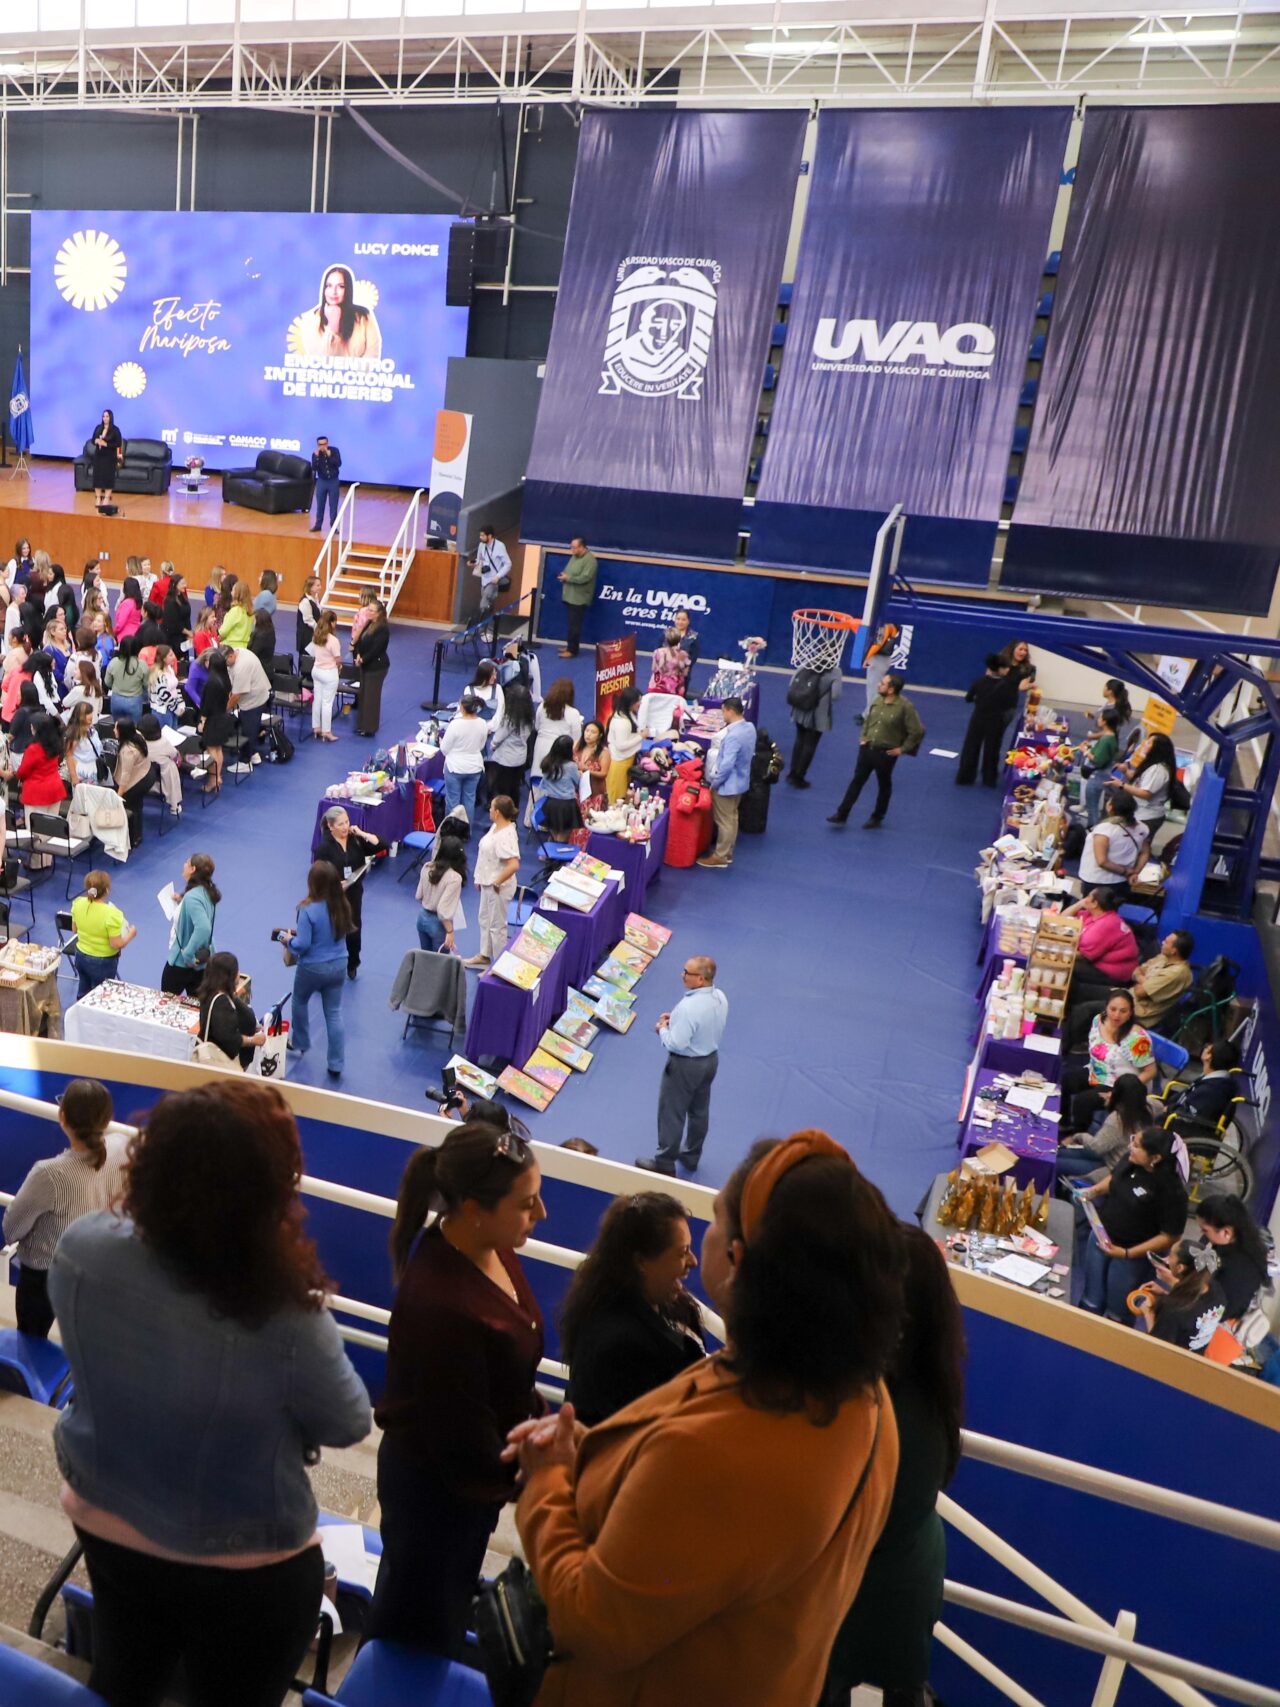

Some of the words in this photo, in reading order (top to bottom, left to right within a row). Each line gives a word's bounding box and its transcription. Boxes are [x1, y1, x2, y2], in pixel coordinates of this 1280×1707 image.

[354, 243, 389, 255] LUCY
[391, 244, 439, 256] PONCE
[616, 256, 658, 282] UNIVERSIDAD
[658, 257, 683, 266] VASCO
[684, 258, 694, 266] DE
[696, 259, 722, 284] QUIROGA
[153, 297, 222, 331] Efecto
[139, 326, 231, 357] Mariposa
[812, 318, 996, 366] UVAQ
[284, 353, 395, 373] ENCUENTRO
[812, 362, 882, 374] UNIVERSIDAD
[884, 366, 920, 375] VASCO
[921, 368, 937, 376] DE
[938, 369, 991, 380] QUIROGA
[264, 366, 415, 389] INTERNACIONAL
[615, 362, 643, 390] EDUCERE
[656, 368, 692, 392] VERITATE
[283, 382, 306, 396] DE
[310, 383, 393, 402] MUJERES
[599, 585, 623, 600] En
[625, 588, 642, 604] la
[646, 590, 711, 615] UVAQ,
[622, 605, 658, 618] eres
[617, 661, 634, 676] PARA
[600, 675, 630, 695] RESISTIR
